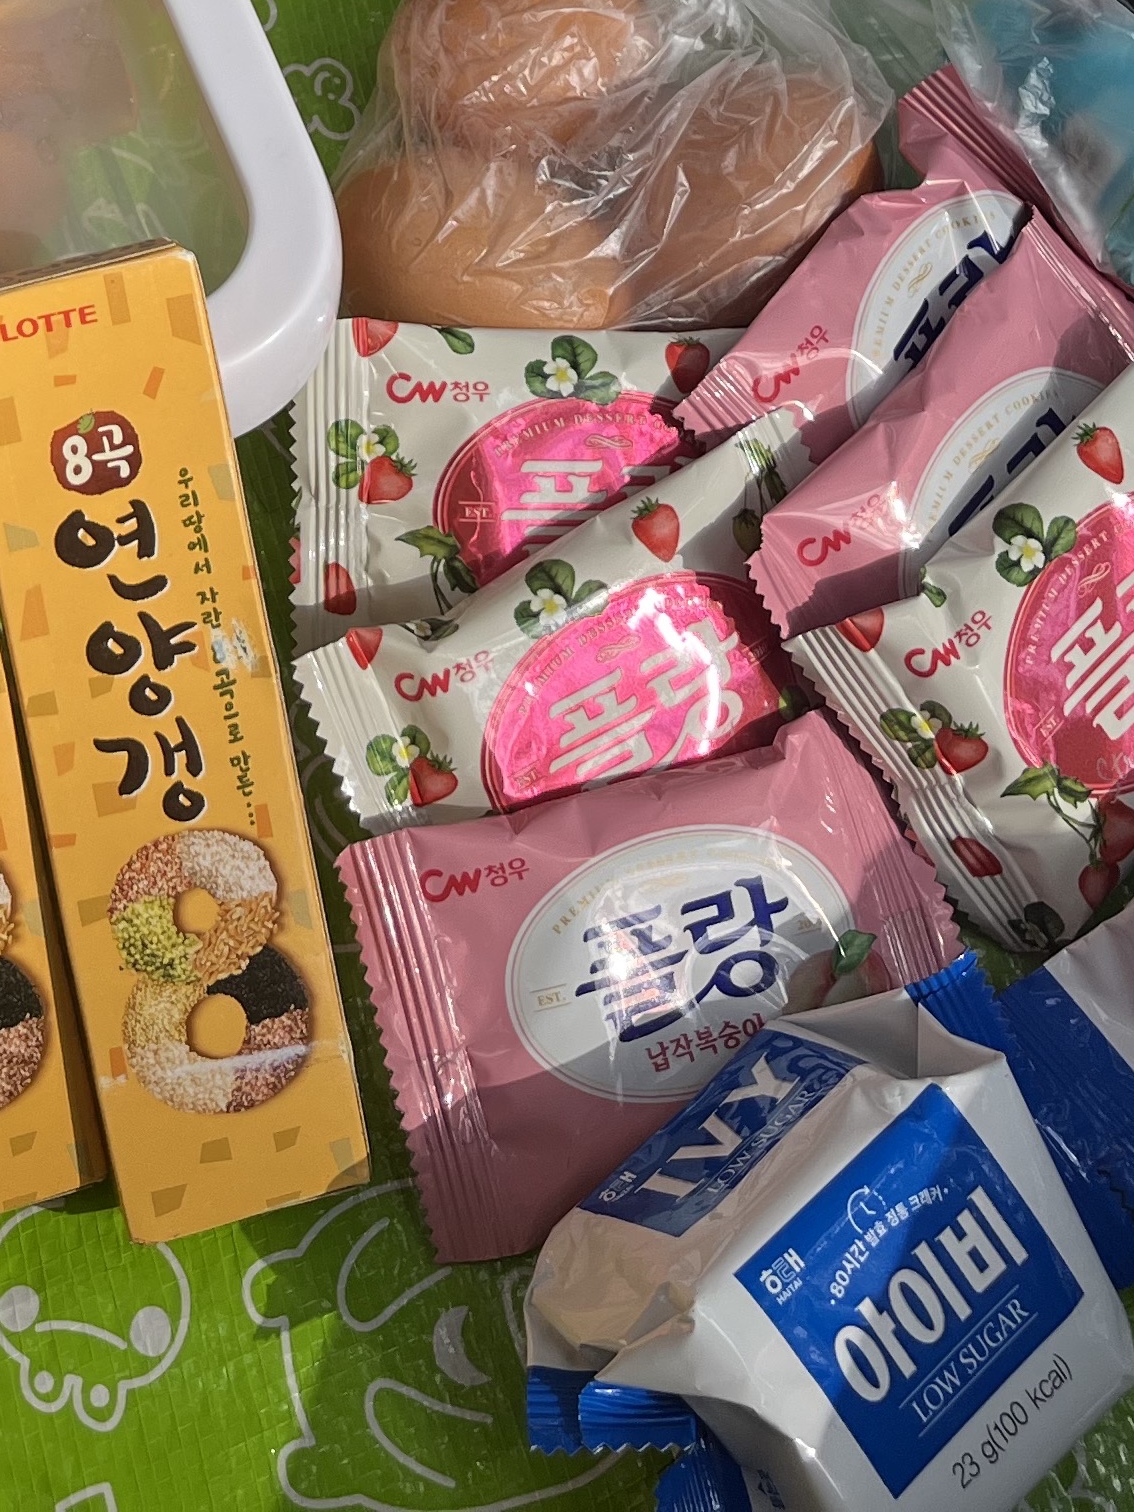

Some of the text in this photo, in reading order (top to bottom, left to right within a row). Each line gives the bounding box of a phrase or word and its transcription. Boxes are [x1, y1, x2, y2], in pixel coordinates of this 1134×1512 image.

[0, 304, 98, 342] LOTTE
[450, 380, 491, 403] 청우
[62, 423, 135, 486] 8곡
[177, 467, 213, 575] 우리땅에서
[196, 586, 223, 629] 자란
[53, 498, 207, 823] 연양갱
[954, 609, 993, 648] 청우
[483, 856, 531, 888] 청우
[575, 874, 790, 1043] 플랑
[634, 1051, 801, 1204] IVY
[706, 1087, 818, 1197] LOW SUGAR
[886, 1201, 910, 1228] 정통
[907, 1183, 946, 1213] 크래커
[832, 1184, 1030, 1403] 아이비
[910, 1297, 1031, 1424] LOW SUGAR
[951, 1451, 982, 1490] 23
[1026, 1351, 1074, 1414] kcal)
